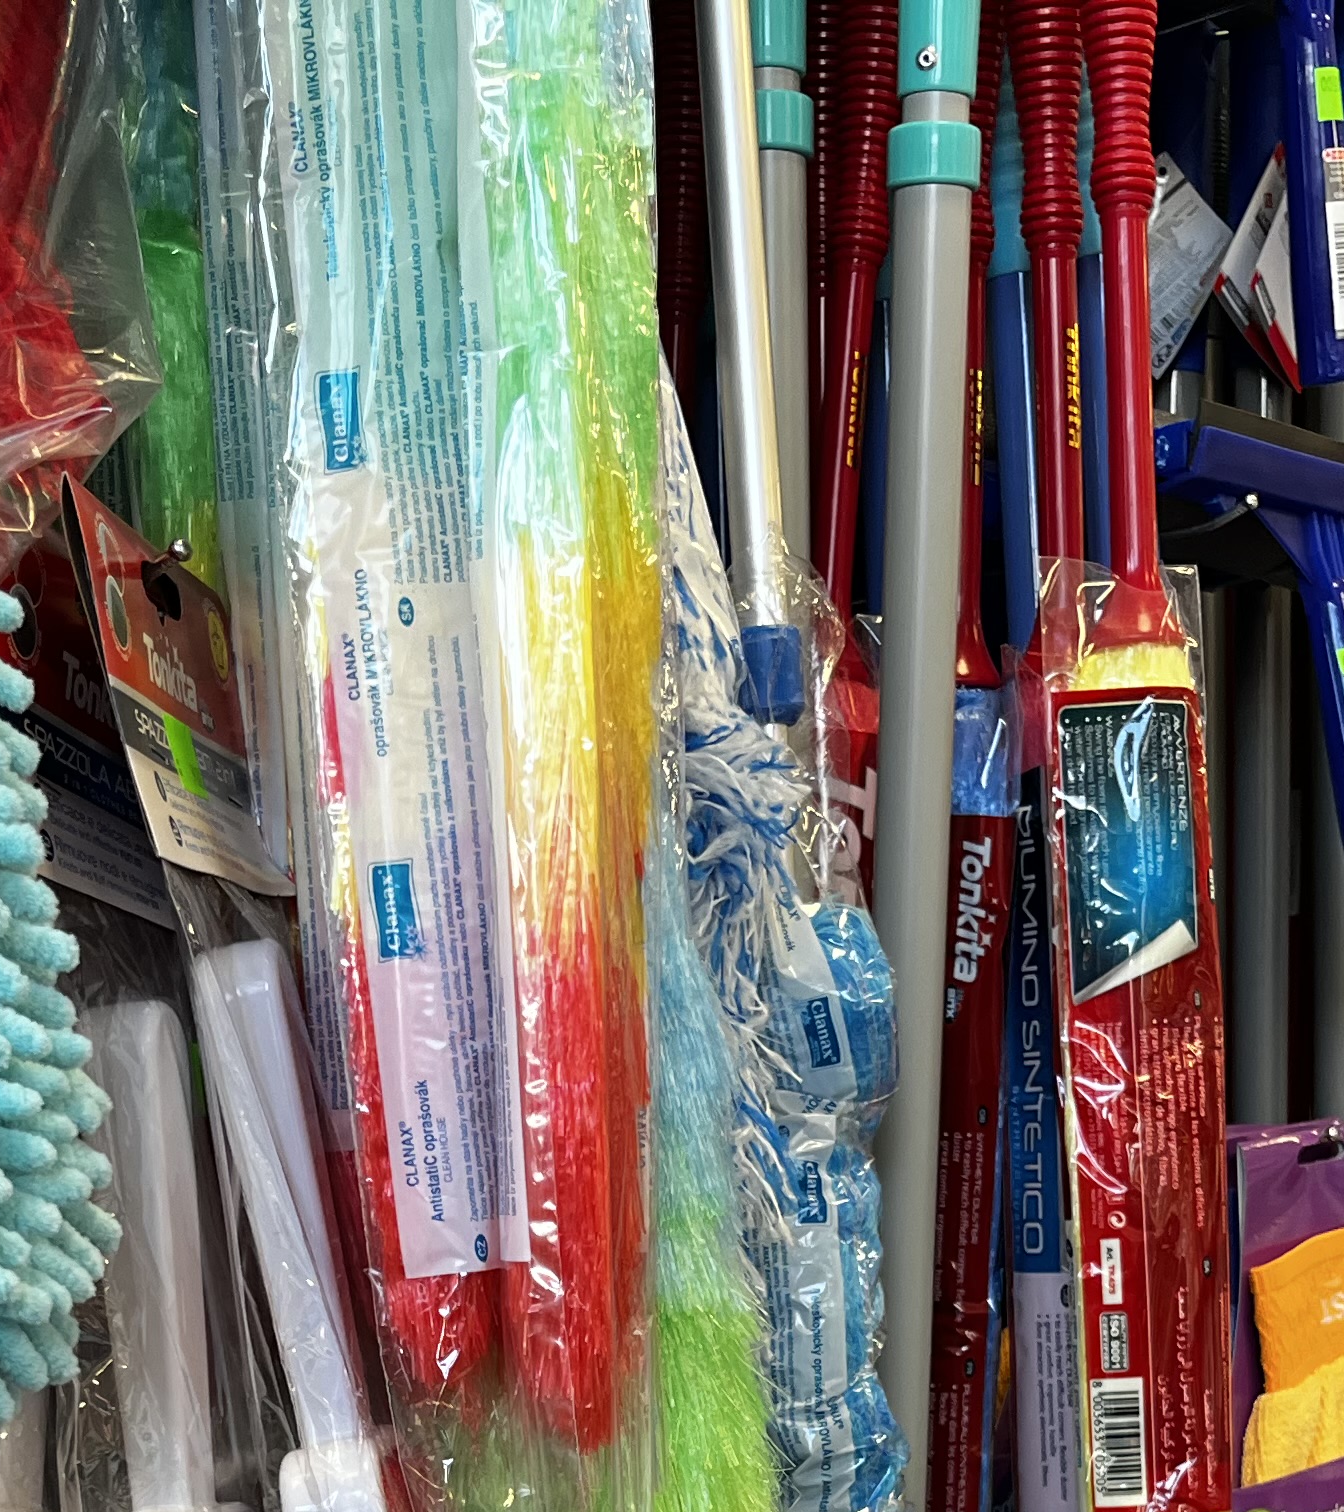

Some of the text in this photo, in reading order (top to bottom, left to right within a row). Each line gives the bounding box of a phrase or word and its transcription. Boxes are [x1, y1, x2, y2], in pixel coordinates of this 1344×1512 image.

[310, 105, 333, 181] oprašovák
[346, 639, 361, 701] CLANAX
[367, 684, 390, 758] oprašovák
[380, 868, 402, 952] Clanax
[953, 836, 991, 984] Tonkita
[812, 1001, 832, 1058] Clanax
[400, 1119, 420, 1188] CLANAX
[414, 1079, 446, 1224] AntistatiC oprašovák
[436, 1116, 454, 1185] CLEAN HOUSE
[1020, 1017, 1045, 1256] SINTETICO
[1109, 1316, 1120, 1368] ISO 9001
[1091, 1396, 1103, 1441] 003653
